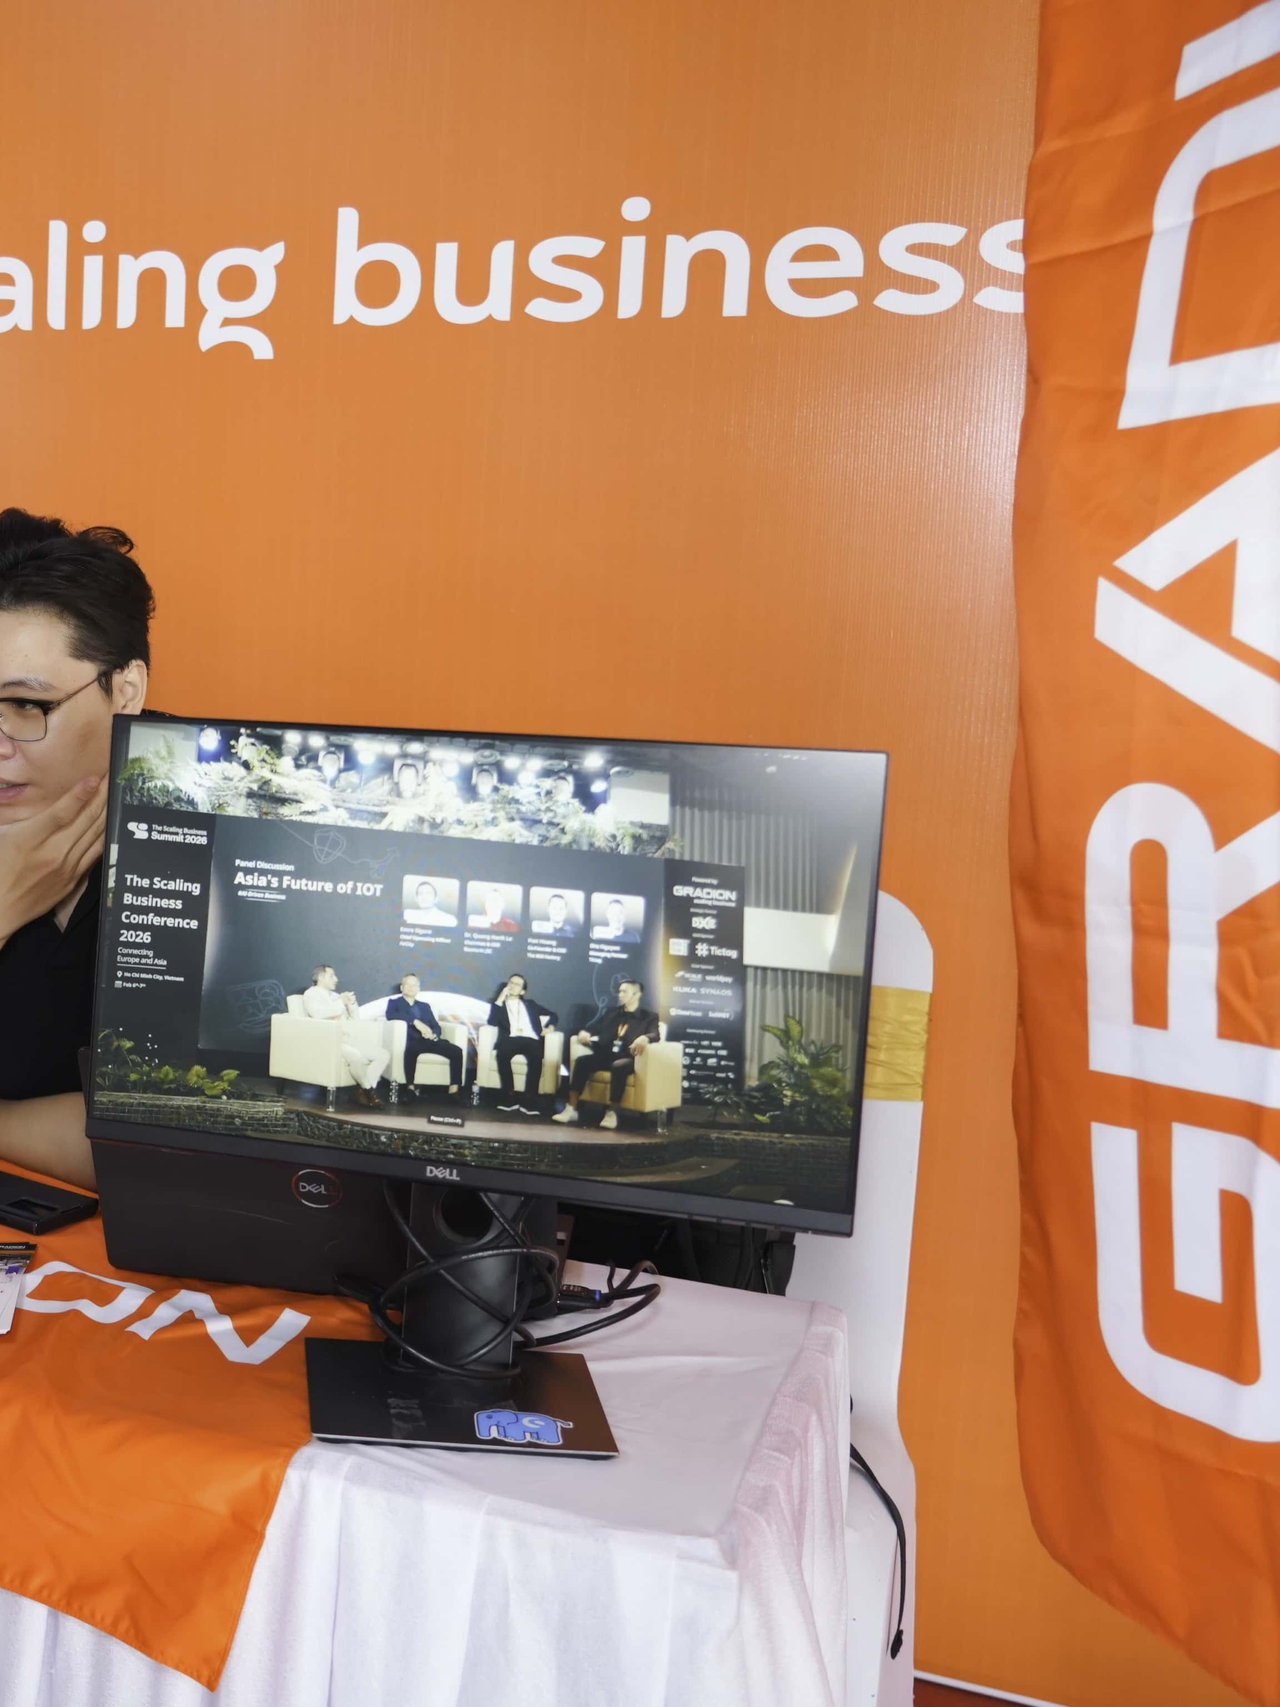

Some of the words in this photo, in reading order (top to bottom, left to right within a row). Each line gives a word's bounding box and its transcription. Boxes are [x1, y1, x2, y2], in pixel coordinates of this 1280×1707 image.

[333, 196, 1025, 326] business
[152, 824, 162, 832] The
[163, 825, 183, 834] Scaling
[184, 828, 207, 836] Business
[151, 831, 184, 842] Summit
[184, 835, 208, 845] 2026
[235, 859, 255, 868] Panel
[257, 861, 295, 872] Discussion
[125, 874, 150, 888] The
[153, 877, 201, 896] Scaling
[234, 871, 279, 888] Asia's
[282, 876, 333, 892] Future
[337, 881, 354, 894] of
[356, 882, 384, 897] IOT
[673, 885, 737, 901] GRADION
[123, 893, 183, 909] Business
[121, 911, 199, 929] Conference
[119, 930, 152, 943] 2026
[117, 946, 154, 957] Connecting
[117, 955, 140, 964] Europe
[141, 957, 153, 965] and
[154, 958, 168, 966] Asia
[426, 1166, 460, 1180] DELL
